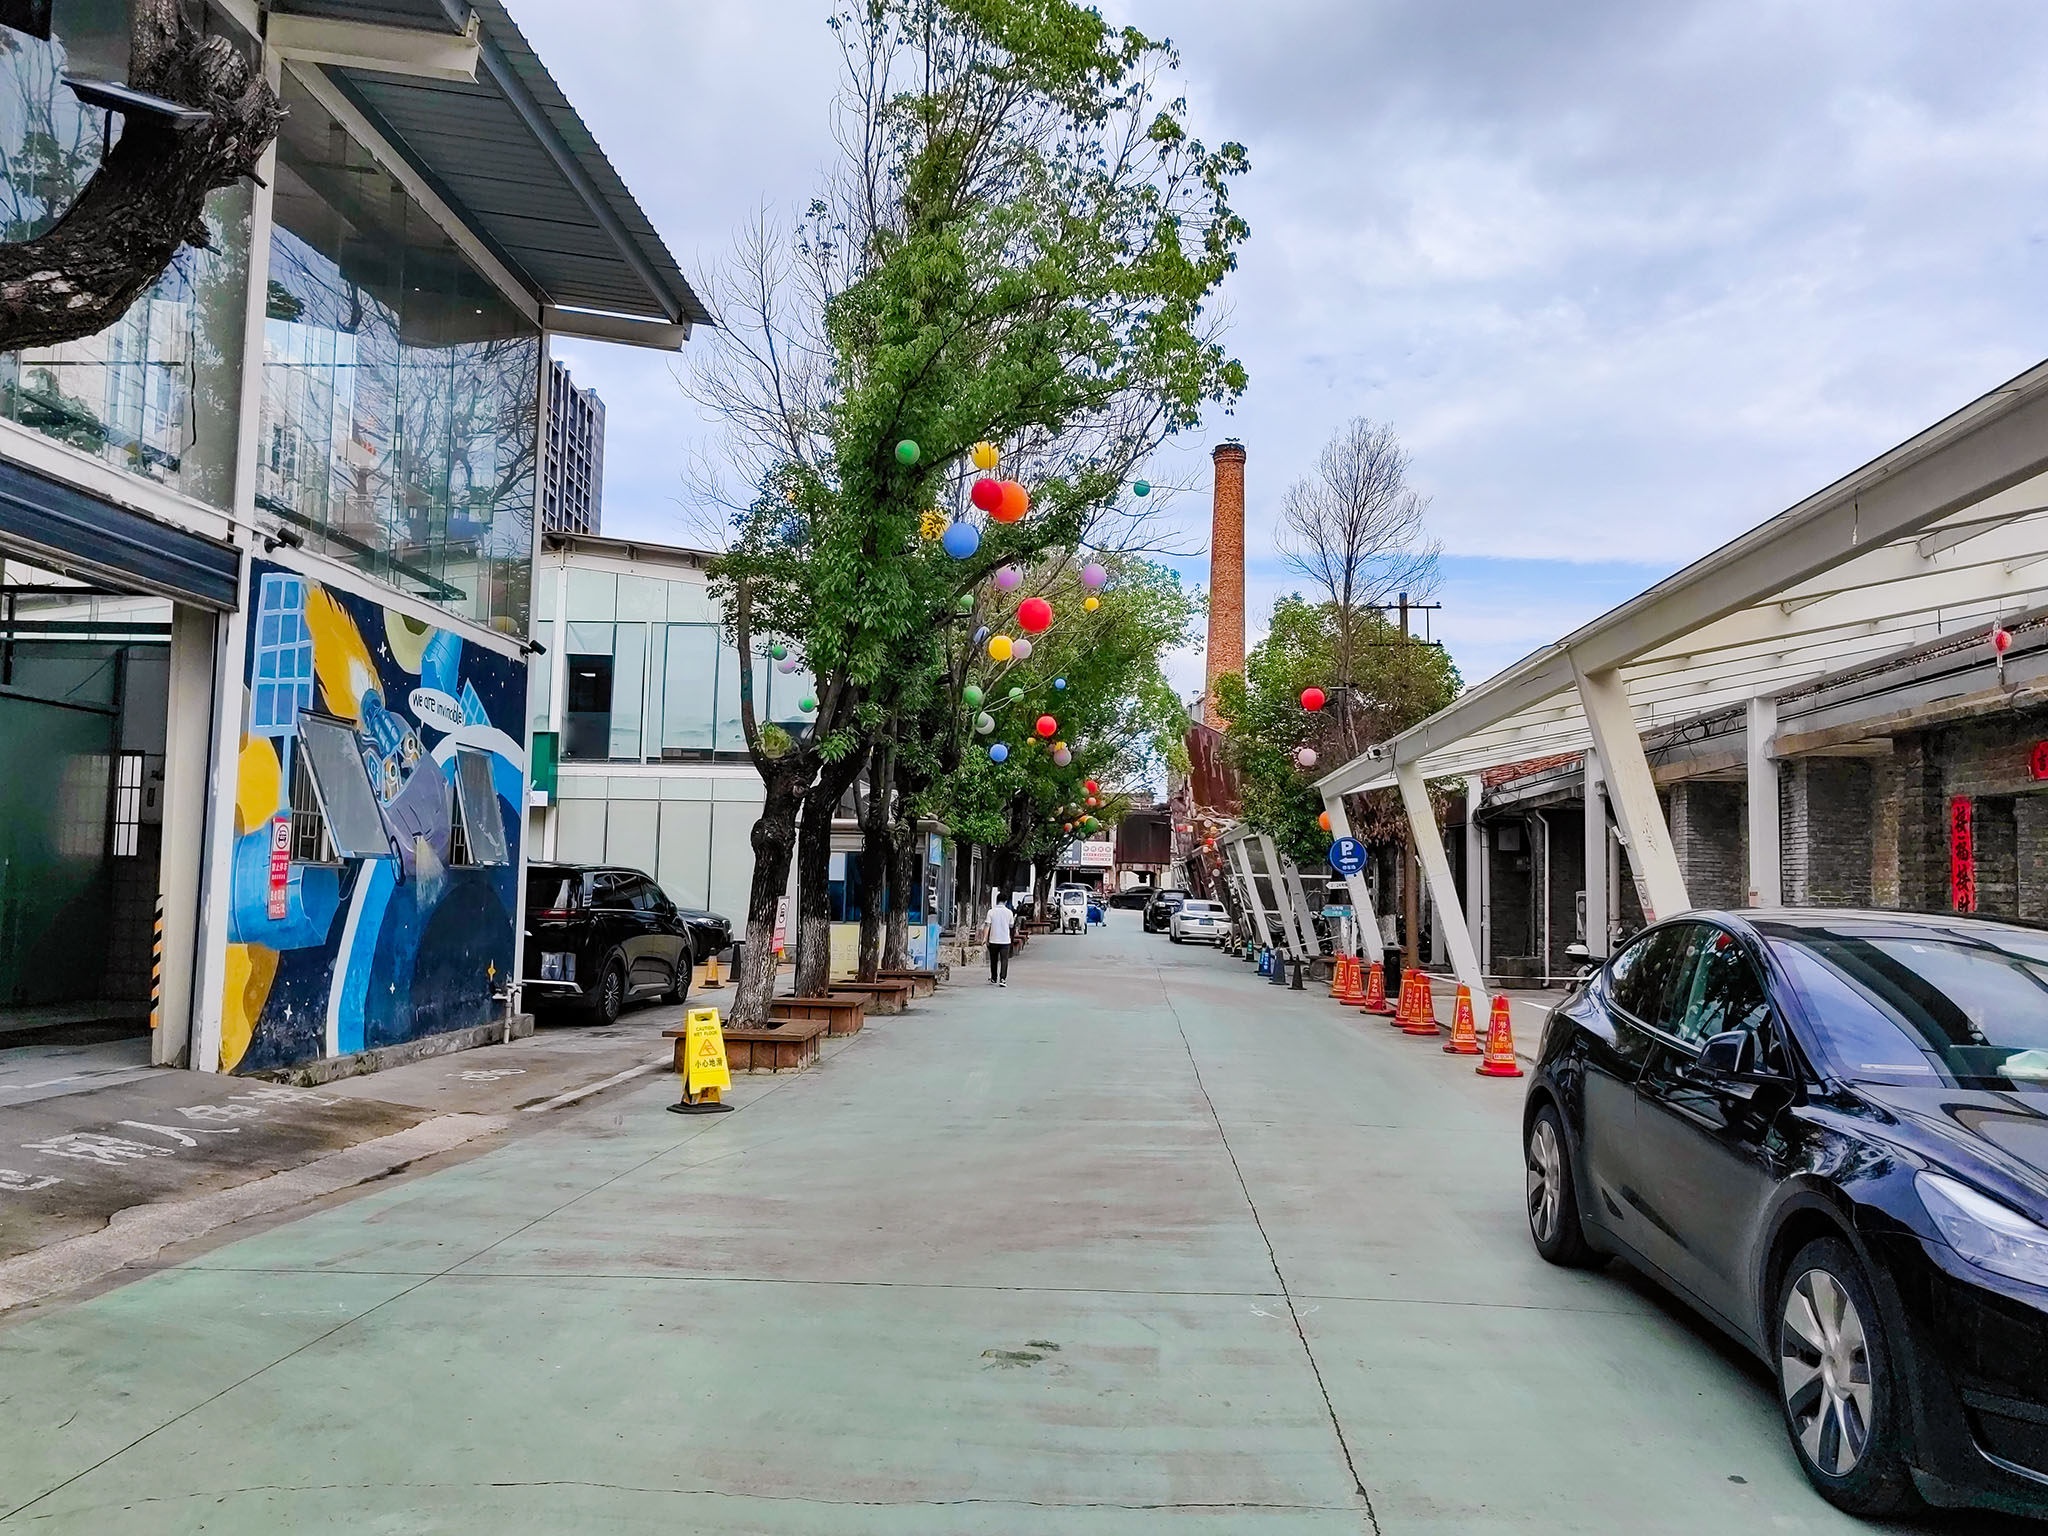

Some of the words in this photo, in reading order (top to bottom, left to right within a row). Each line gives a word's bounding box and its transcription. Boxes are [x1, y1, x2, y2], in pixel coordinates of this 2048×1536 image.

[1341, 841, 1354, 856] P
[695, 1058, 722, 1069] 小心地滑
